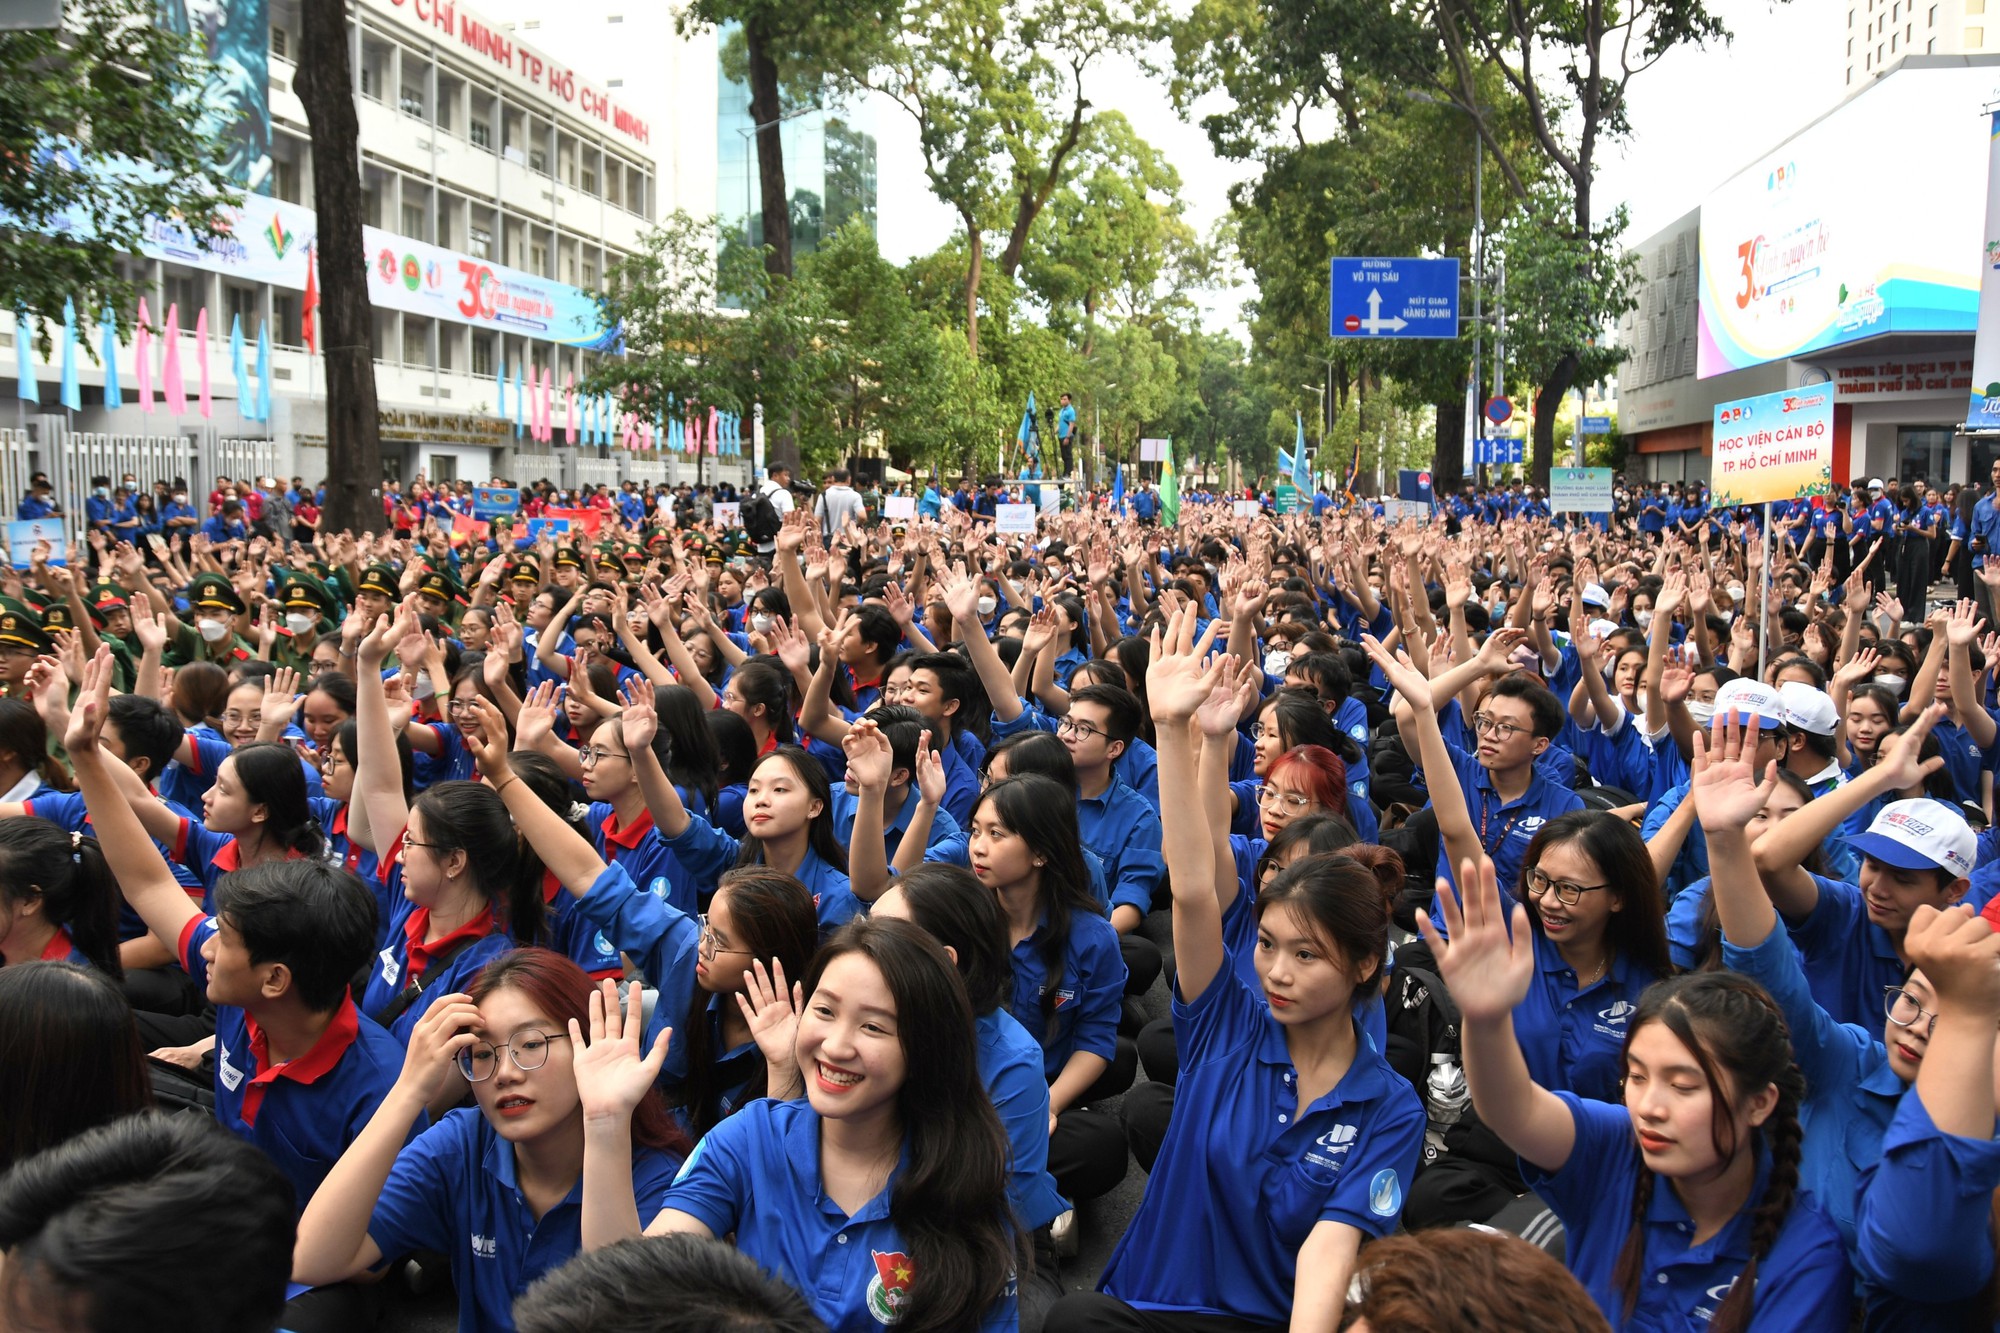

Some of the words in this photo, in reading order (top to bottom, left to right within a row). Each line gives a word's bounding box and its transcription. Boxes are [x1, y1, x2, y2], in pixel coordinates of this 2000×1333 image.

[461, 14, 512, 68] MINH
[517, 48, 543, 84] TP.
[548, 66, 575, 103] HỒ
[580, 87, 609, 122] CHÍ
[613, 104, 648, 146] MINH
[1352, 270, 1365, 282] VÕ
[1366, 272, 1380, 283] THỊ
[1383, 270, 1399, 282] SÁU
[1409, 297, 1426, 305] NÚT
[1403, 306, 1426, 318] HÀNG
[1428, 308, 1451, 319] XANH
[1837, 366, 1875, 378] TRUNG
[1878, 362, 1904, 376] TÂM
[1837, 379, 1875, 394] THÀNH
[1878, 376, 1903, 392] PHỐ
[1906, 376, 1923, 391] HỒ
[1926, 375, 1948, 389] CHÍ
[1718, 438, 1743, 453] HỌC
[1747, 429, 1773, 447] VIỆN
[1775, 426, 1803, 443] CÁN
[1806, 420, 1825, 440] BỘ
[1723, 461, 1737, 473] TP.
[1740, 450, 1757, 470] HỒ
[1759, 454, 1781, 468] CHÍ
[1784, 448, 1818, 465] MINH
[1905, 818, 1931, 835] 2023
